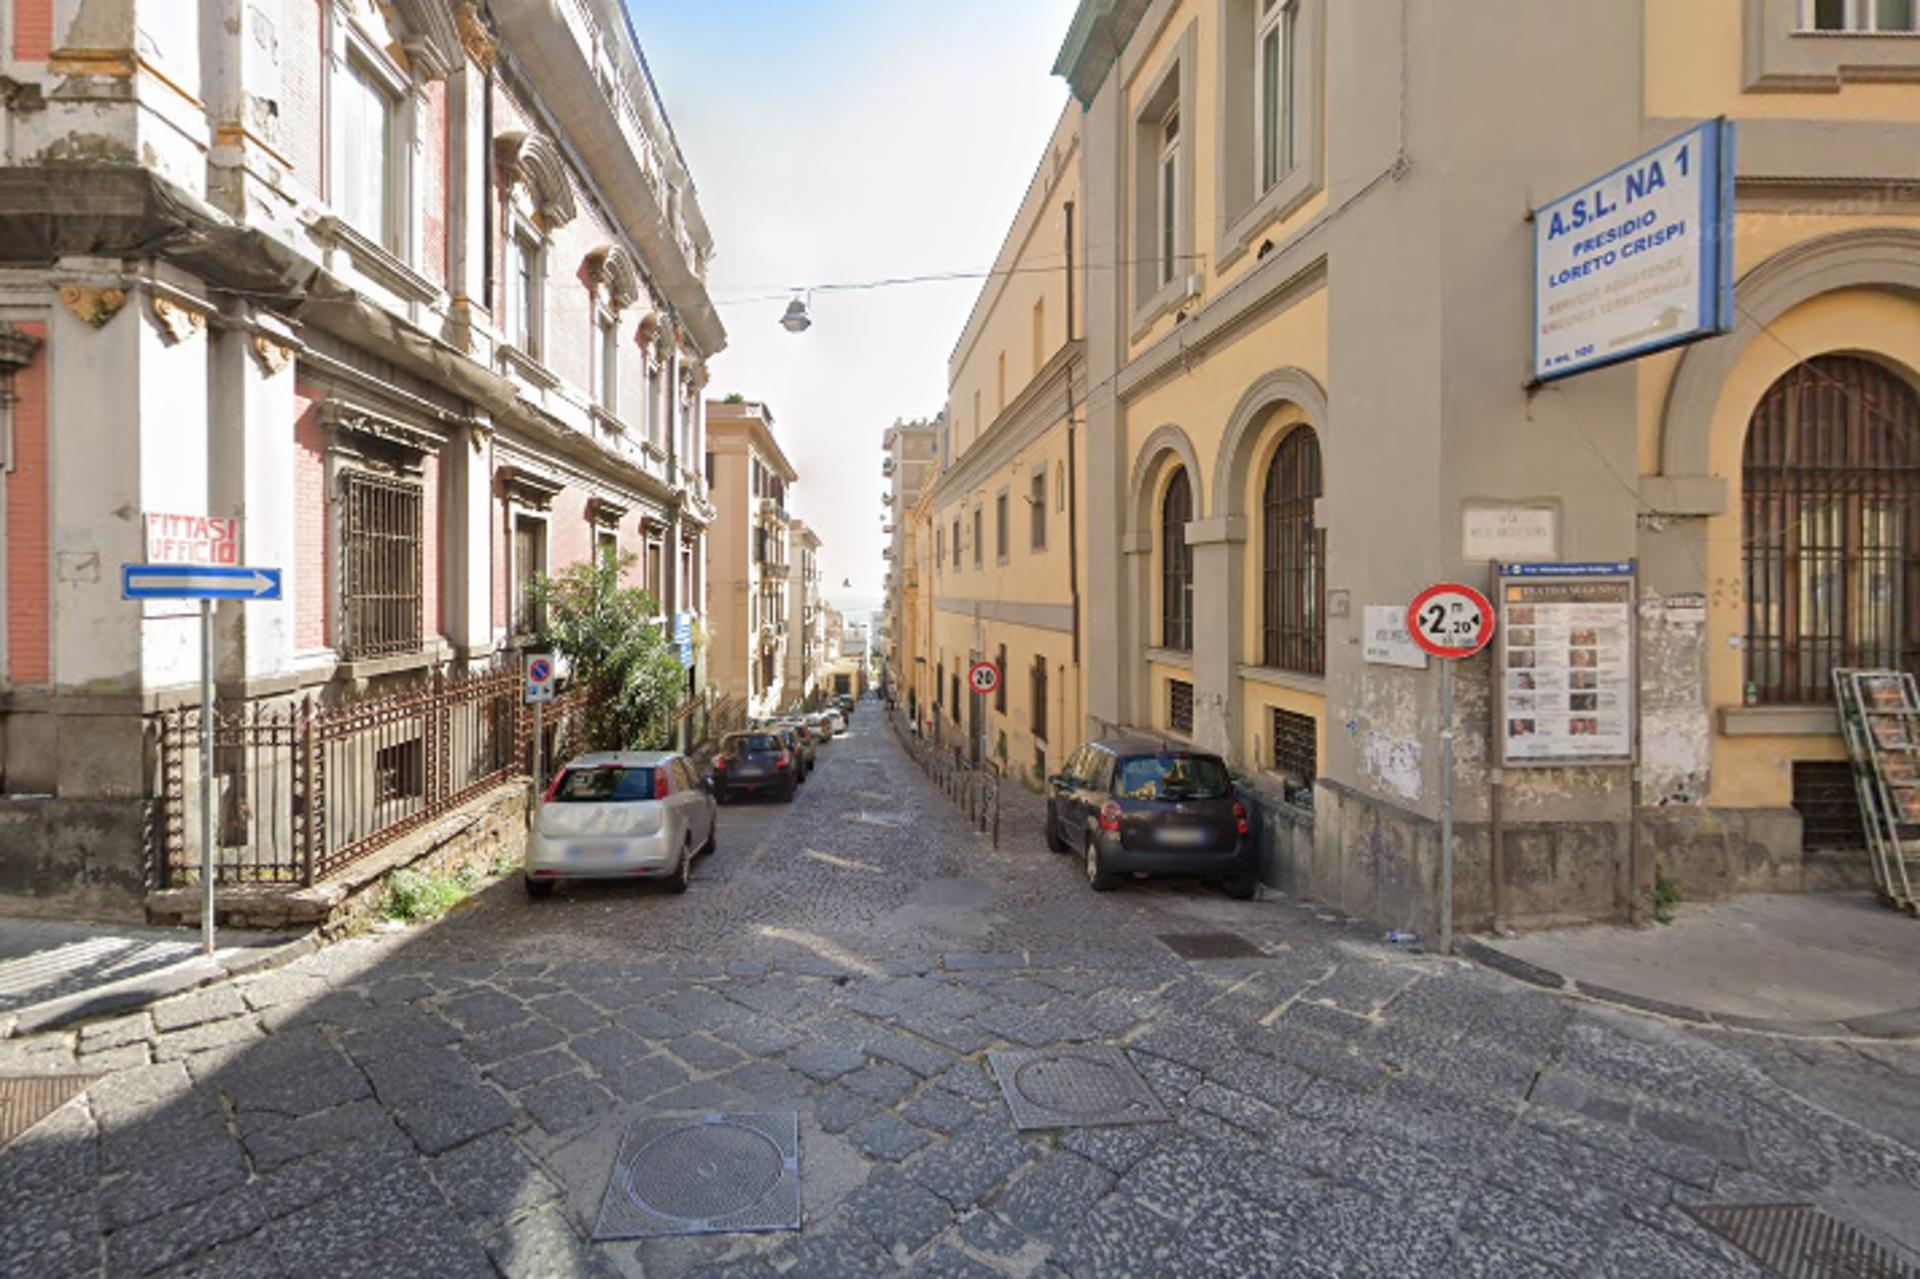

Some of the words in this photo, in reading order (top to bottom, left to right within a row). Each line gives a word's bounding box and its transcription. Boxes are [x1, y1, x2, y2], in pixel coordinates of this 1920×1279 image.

[1547, 190, 1617, 241] A.S.L.
[1625, 160, 1666, 206] NA
[1674, 145, 1690, 177] 1
[1572, 209, 1657, 258] PRESIDIO
[1549, 250, 1616, 288] LORETO
[1620, 220, 1686, 259] CRISPI
[148, 512, 238, 540] FITTASI
[149, 538, 237, 564] UFFICIO
[1428, 604, 1446, 632] 2
[975, 670, 994, 685] 20
